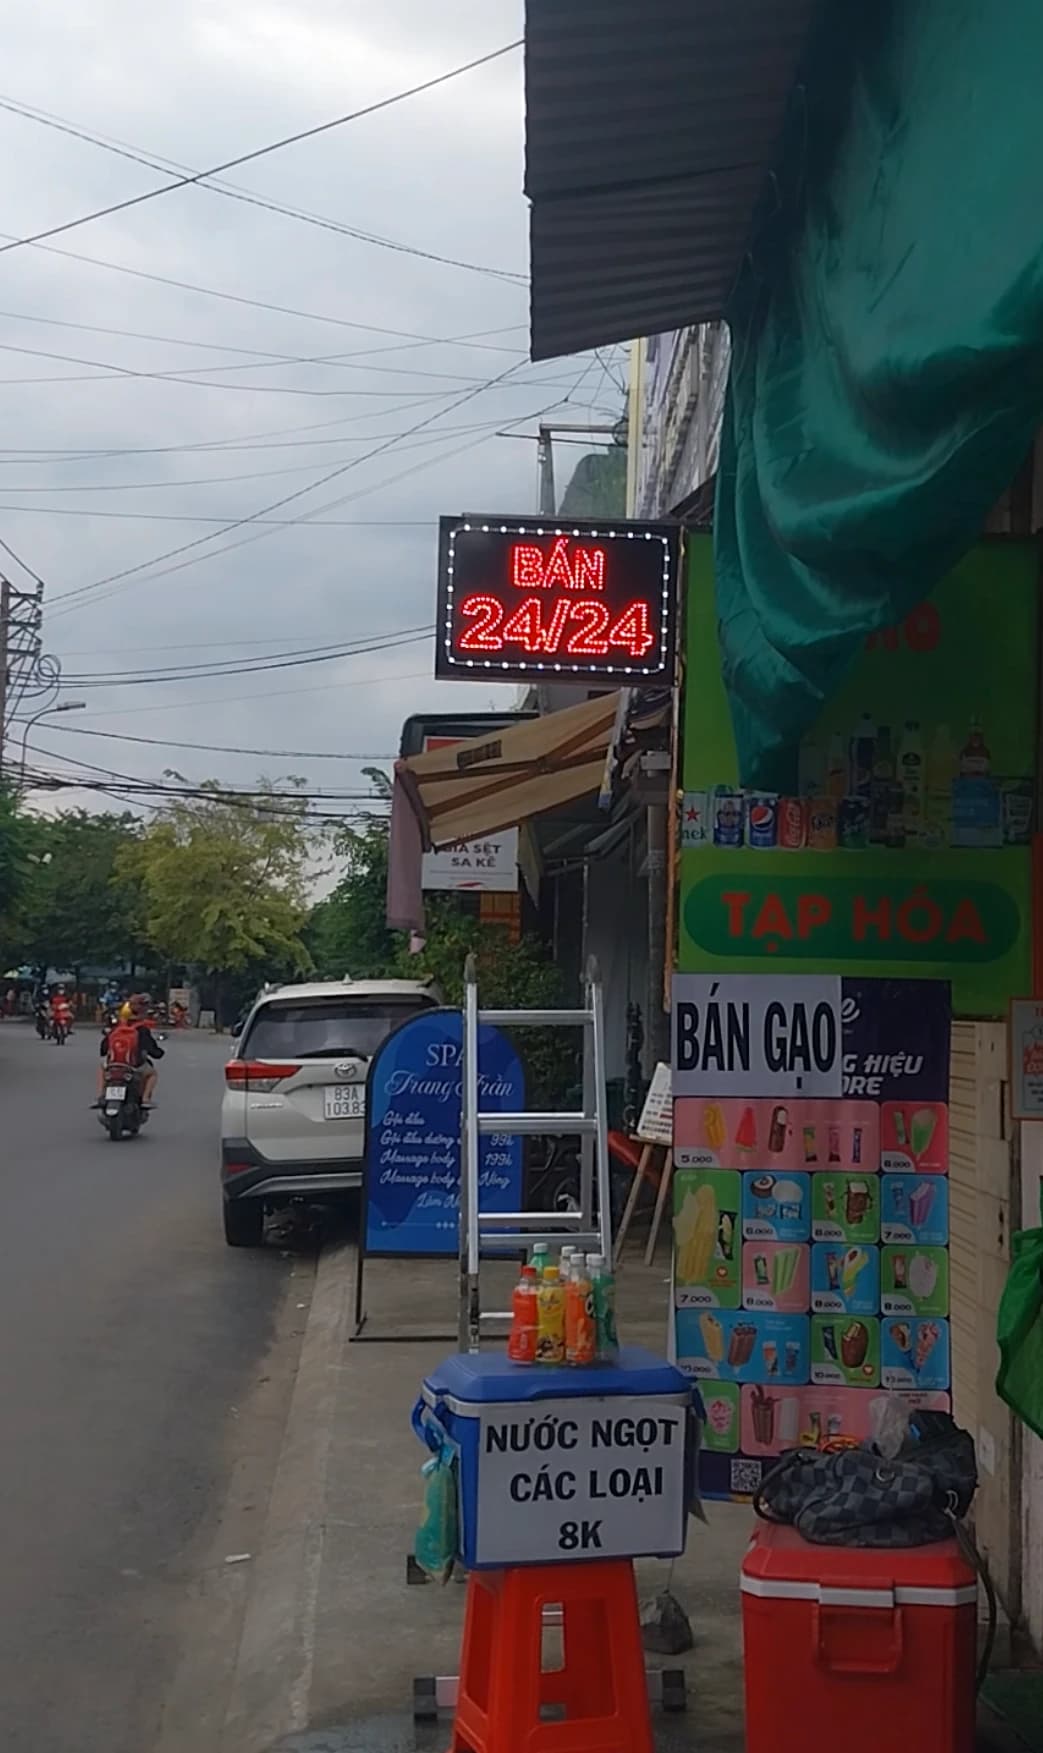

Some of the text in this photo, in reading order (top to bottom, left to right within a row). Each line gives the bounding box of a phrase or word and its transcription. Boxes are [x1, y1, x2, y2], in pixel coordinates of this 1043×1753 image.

[512, 537, 605, 590] BÁN
[459, 597, 653, 656] 24/24
[451, 857, 472, 868] SA
[722, 885, 989, 953] TẠP HÓA
[676, 982, 837, 1089] BÁN GẠO
[863, 1051, 924, 1078] HIỆU
[334, 1087, 359, 1101] 83A
[384, 1070, 455, 1102] Trang
[379, 1149, 429, 1168] Massage
[430, 1151, 456, 1168] body
[680, 1155, 713, 1164] 5.000
[379, 1169, 429, 1188] Massage
[430, 1170, 456, 1189] body
[885, 1231, 912, 1239] 7.000
[680, 1295, 712, 1304] 7.000
[486, 1414, 679, 1453] NƯỚC NGỌT
[510, 1464, 664, 1503] CÁC LOẠI
[558, 1520, 603, 1550] 8K
